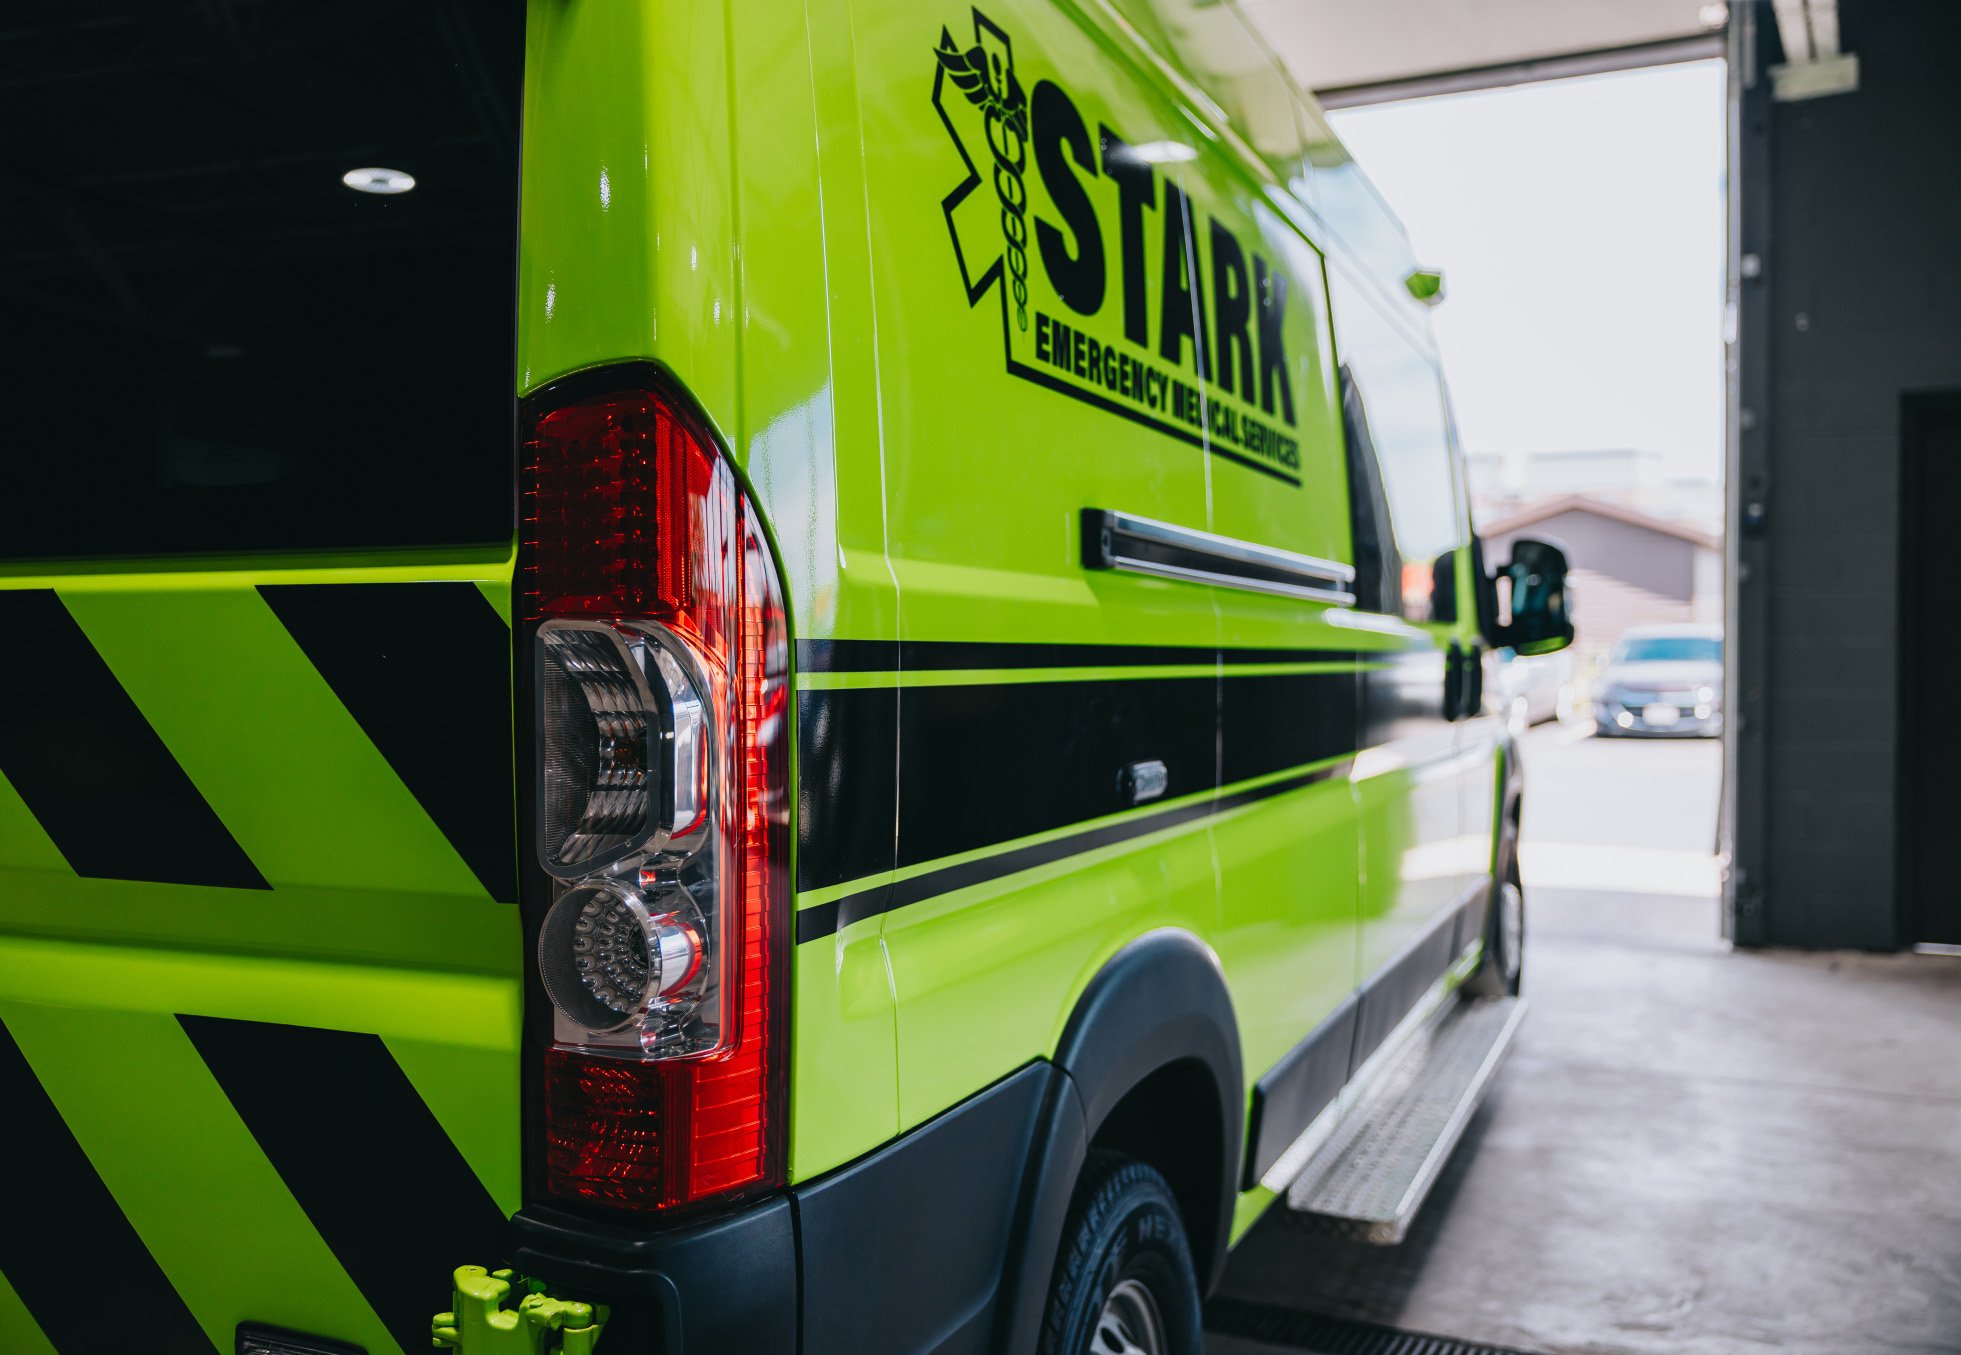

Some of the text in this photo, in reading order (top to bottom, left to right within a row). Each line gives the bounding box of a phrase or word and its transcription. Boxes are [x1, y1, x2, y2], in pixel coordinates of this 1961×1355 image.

[1031, 80, 1297, 426] STARK
[1035, 311, 1169, 413] EMERGENCY
[1241, 415, 1300, 470] SERVICES
